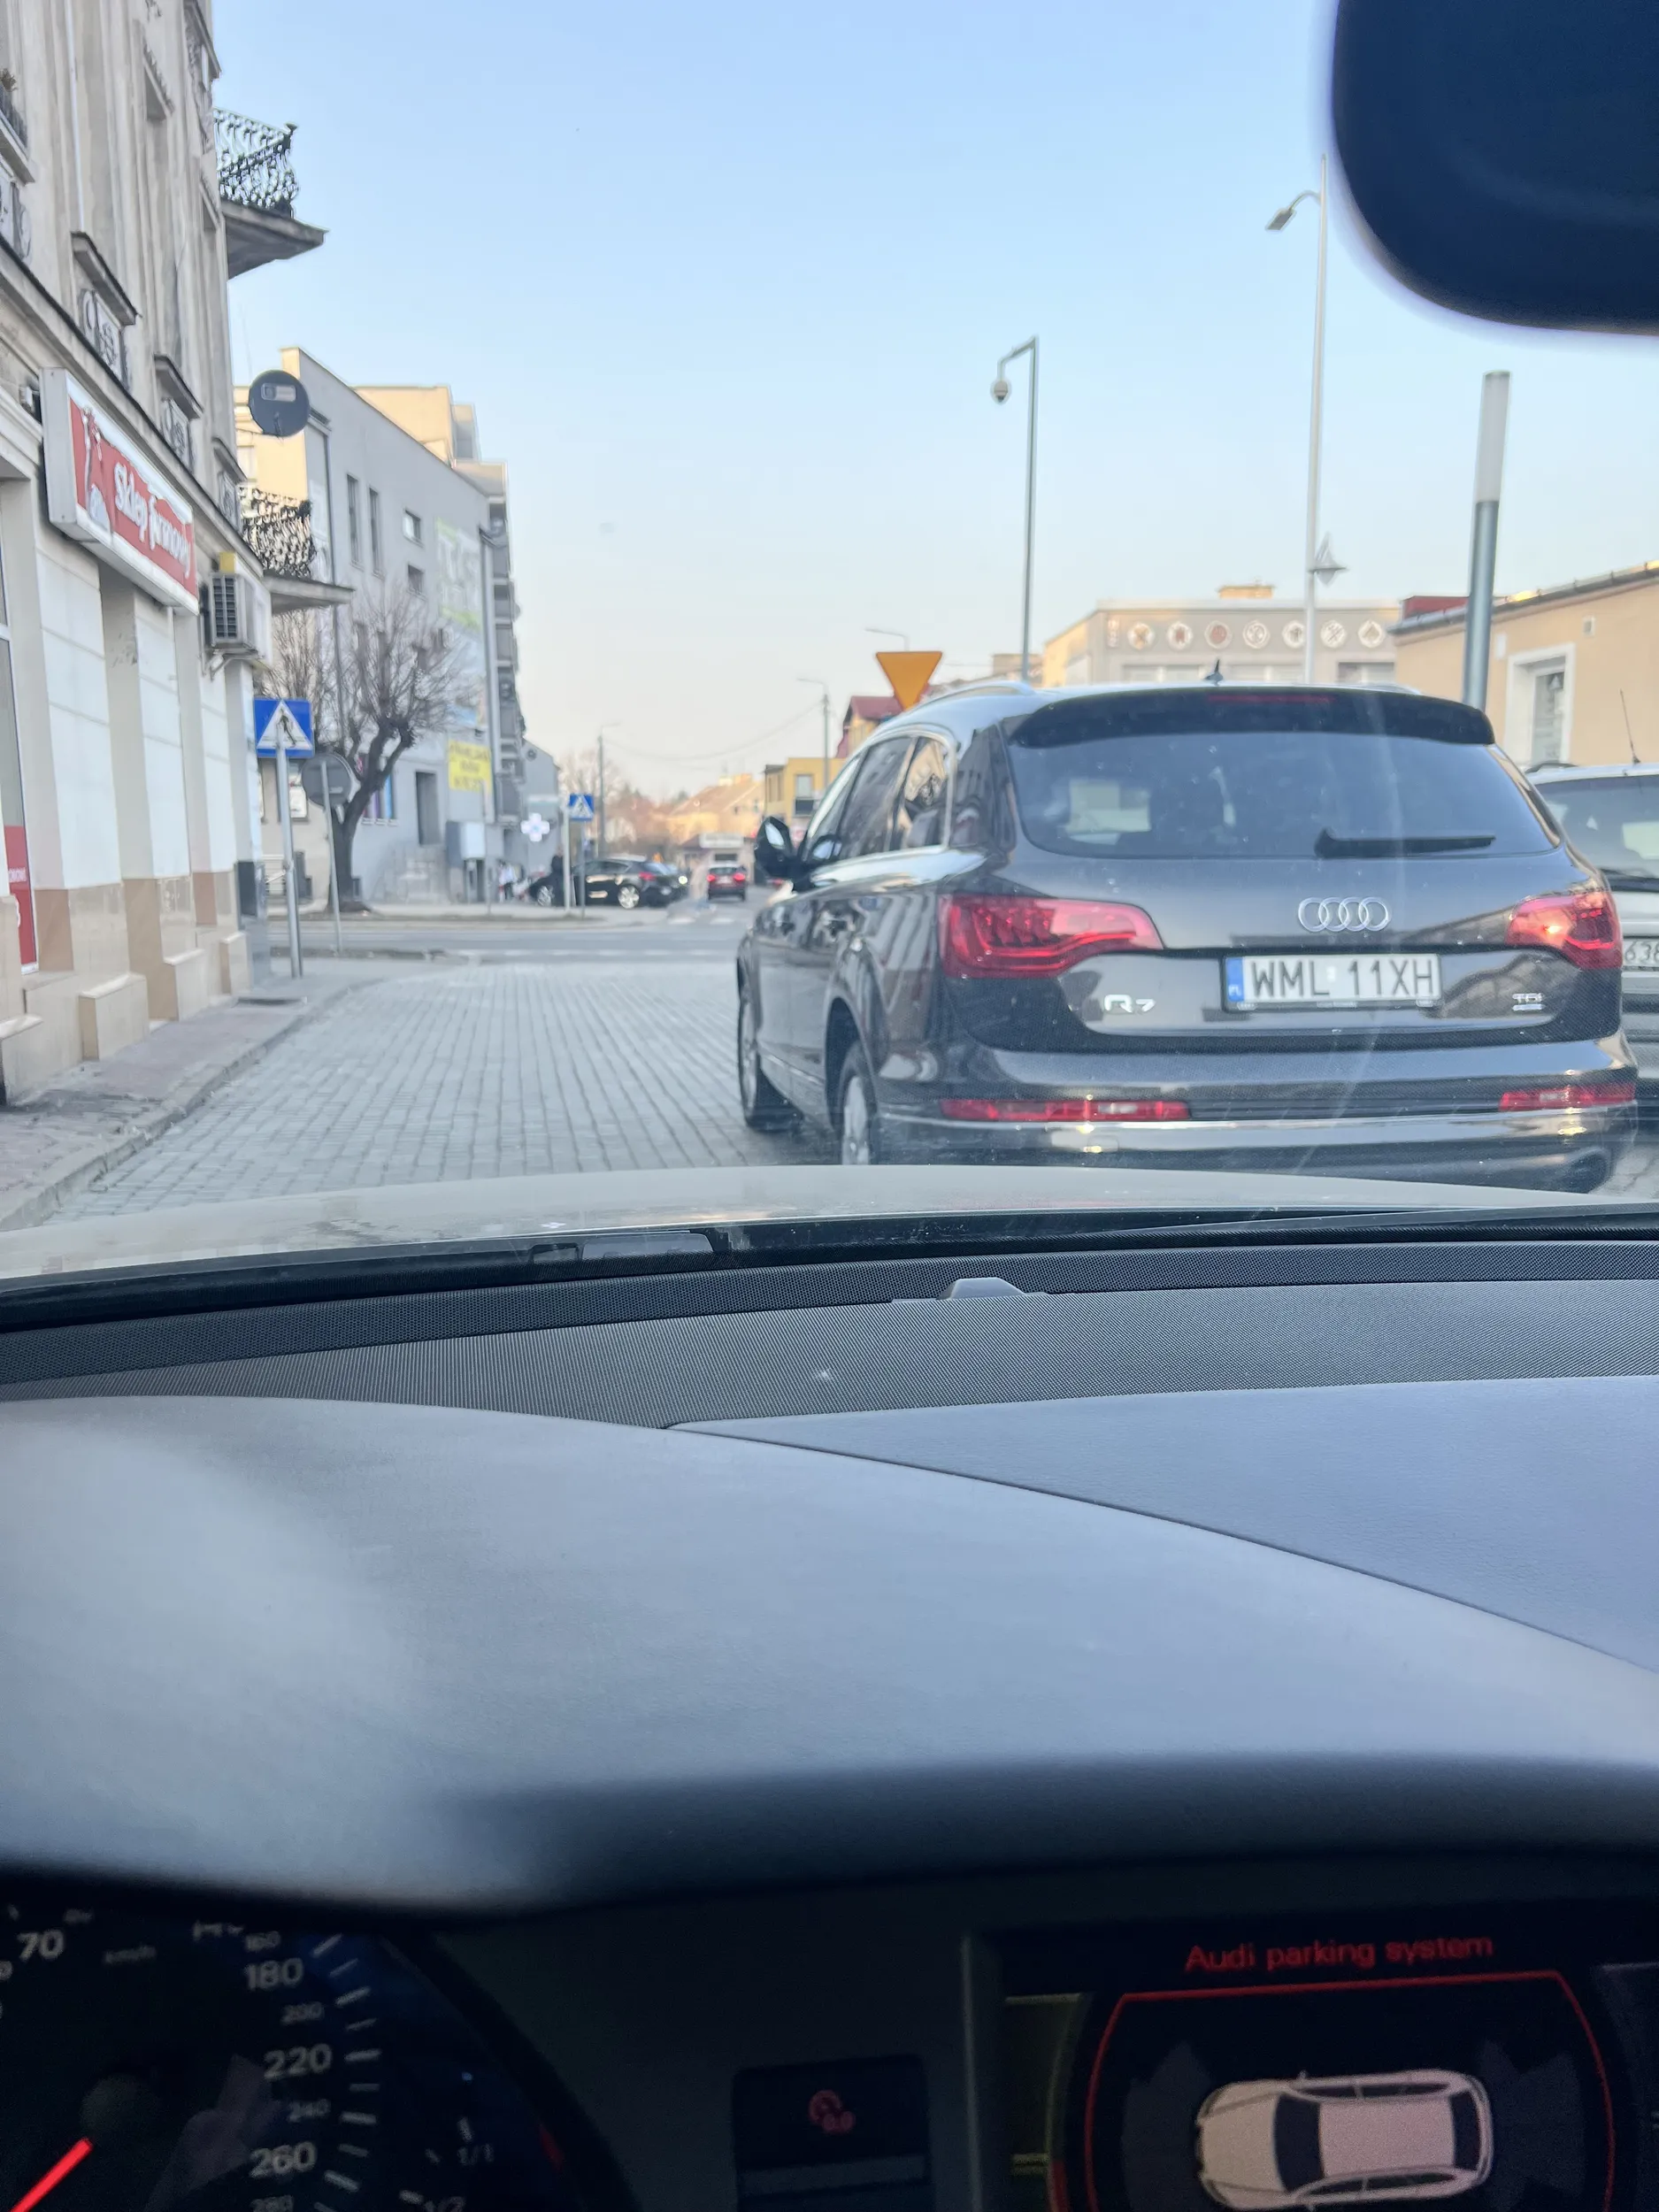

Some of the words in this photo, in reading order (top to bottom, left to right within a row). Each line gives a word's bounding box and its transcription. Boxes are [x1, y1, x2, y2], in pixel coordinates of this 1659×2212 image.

[1251, 959, 1330, 997] WML
[1348, 959, 1434, 996] 11XH
[17, 1929, 65, 1962] 70
[1184, 1942, 1256, 1973] Audi
[1263, 1937, 1377, 1973] parking
[1385, 1935, 1494, 1966] system
[243, 1956, 304, 1991] 180
[264, 2042, 333, 2080] 220
[249, 2139, 318, 2179] 260
